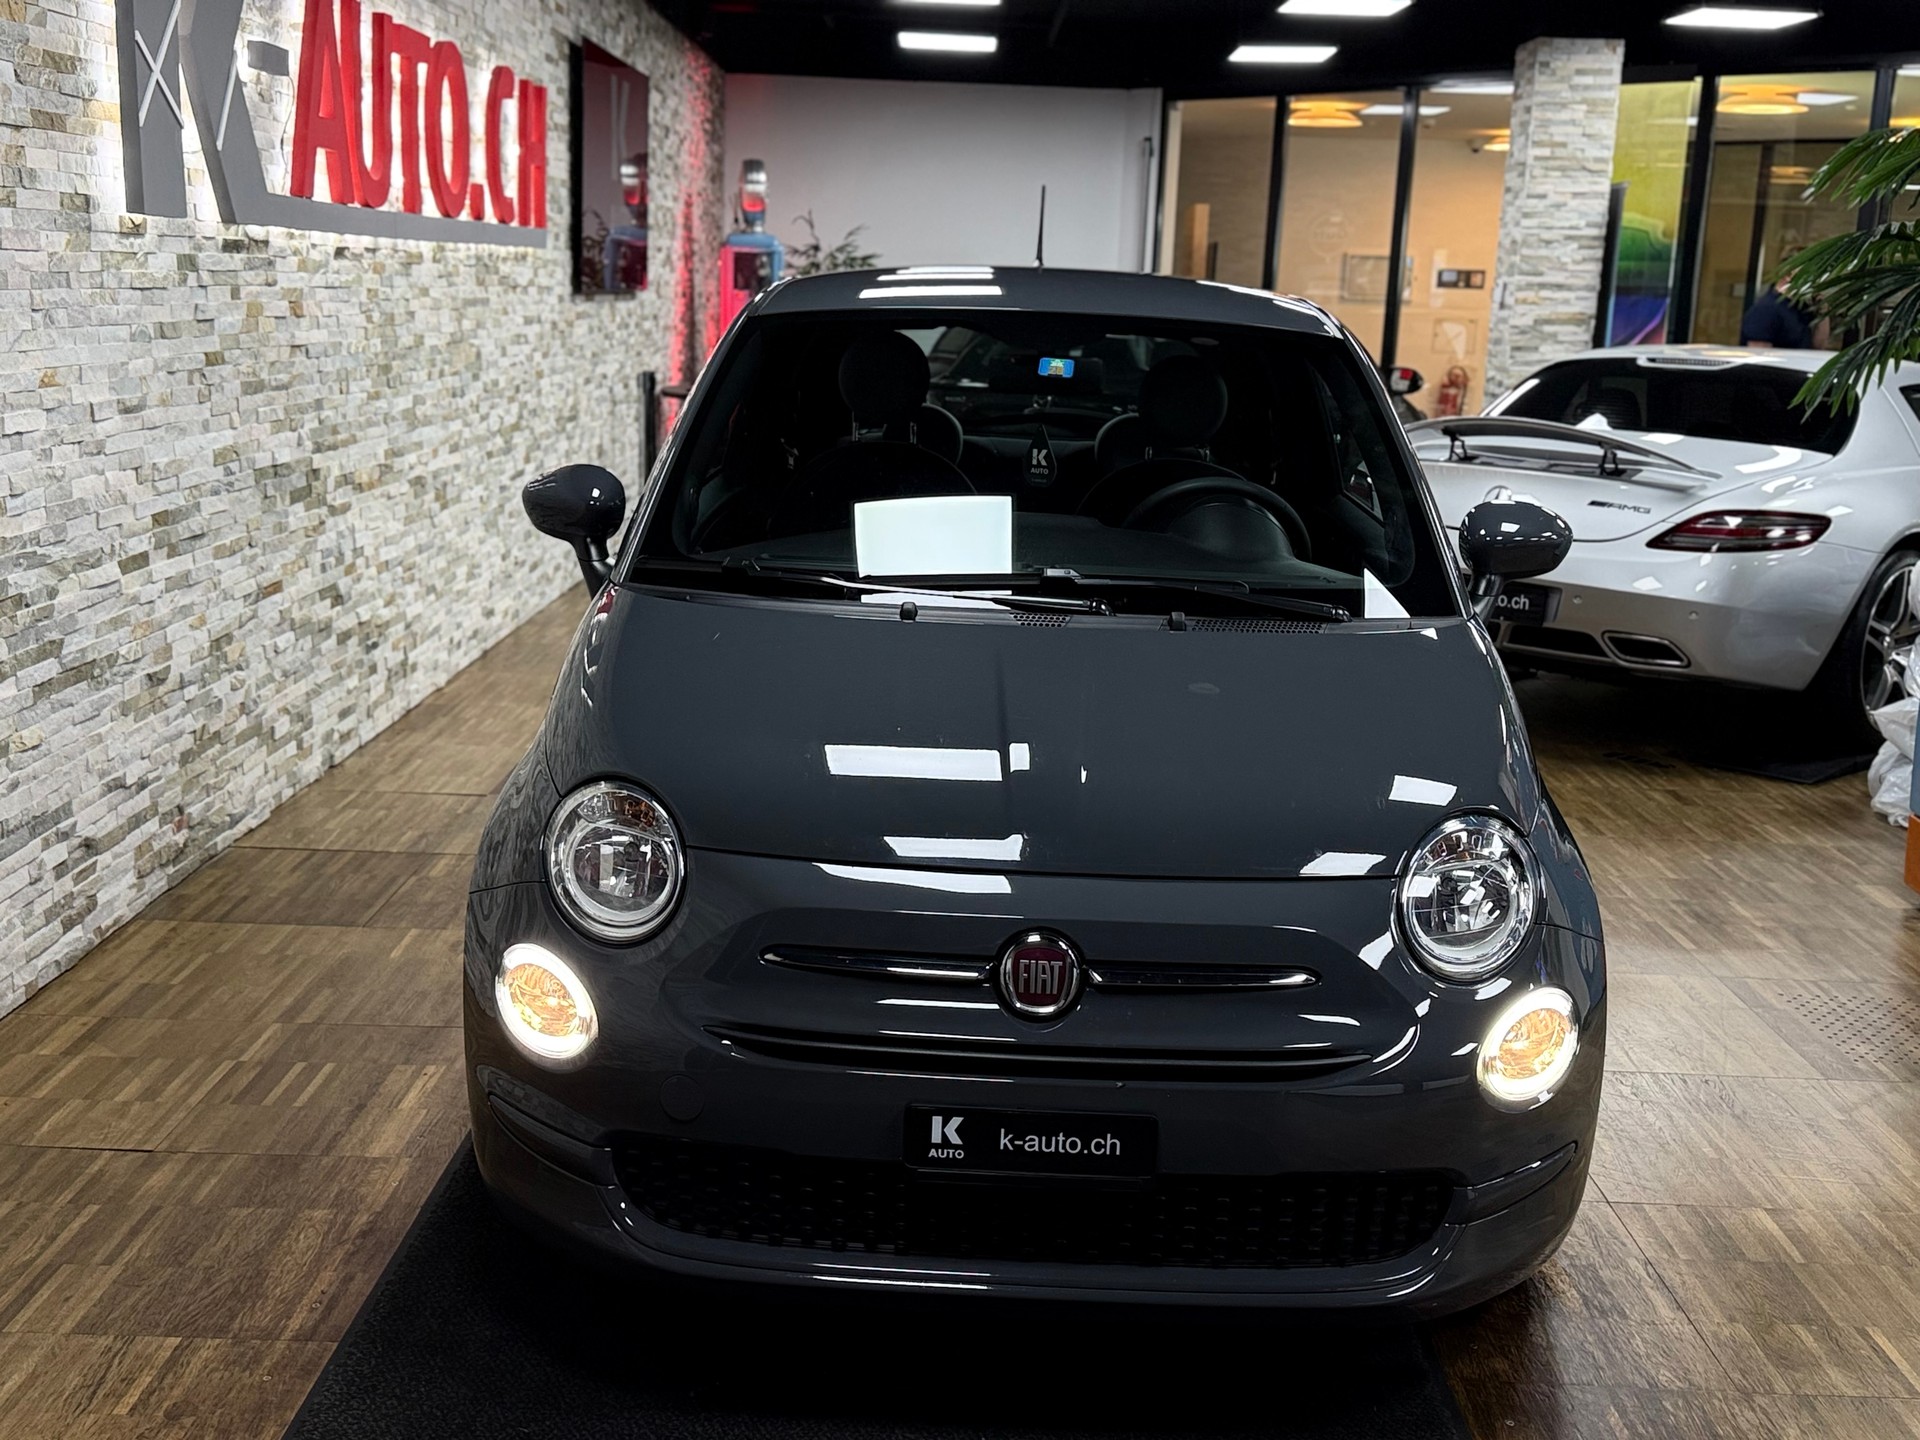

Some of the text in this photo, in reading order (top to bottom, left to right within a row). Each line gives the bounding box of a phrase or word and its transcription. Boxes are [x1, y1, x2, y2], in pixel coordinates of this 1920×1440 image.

[1032, 448, 1048, 466] K
[1030, 467, 1049, 475] AUTO
[1606, 502, 1651, 514] AMG
[1496, 594, 1530, 611] o.ch
[1018, 959, 1063, 995] FIAT
[931, 1115, 965, 1145] K
[999, 1128, 1121, 1156] k-auto.ch
[928, 1148, 965, 1159] AUTO
